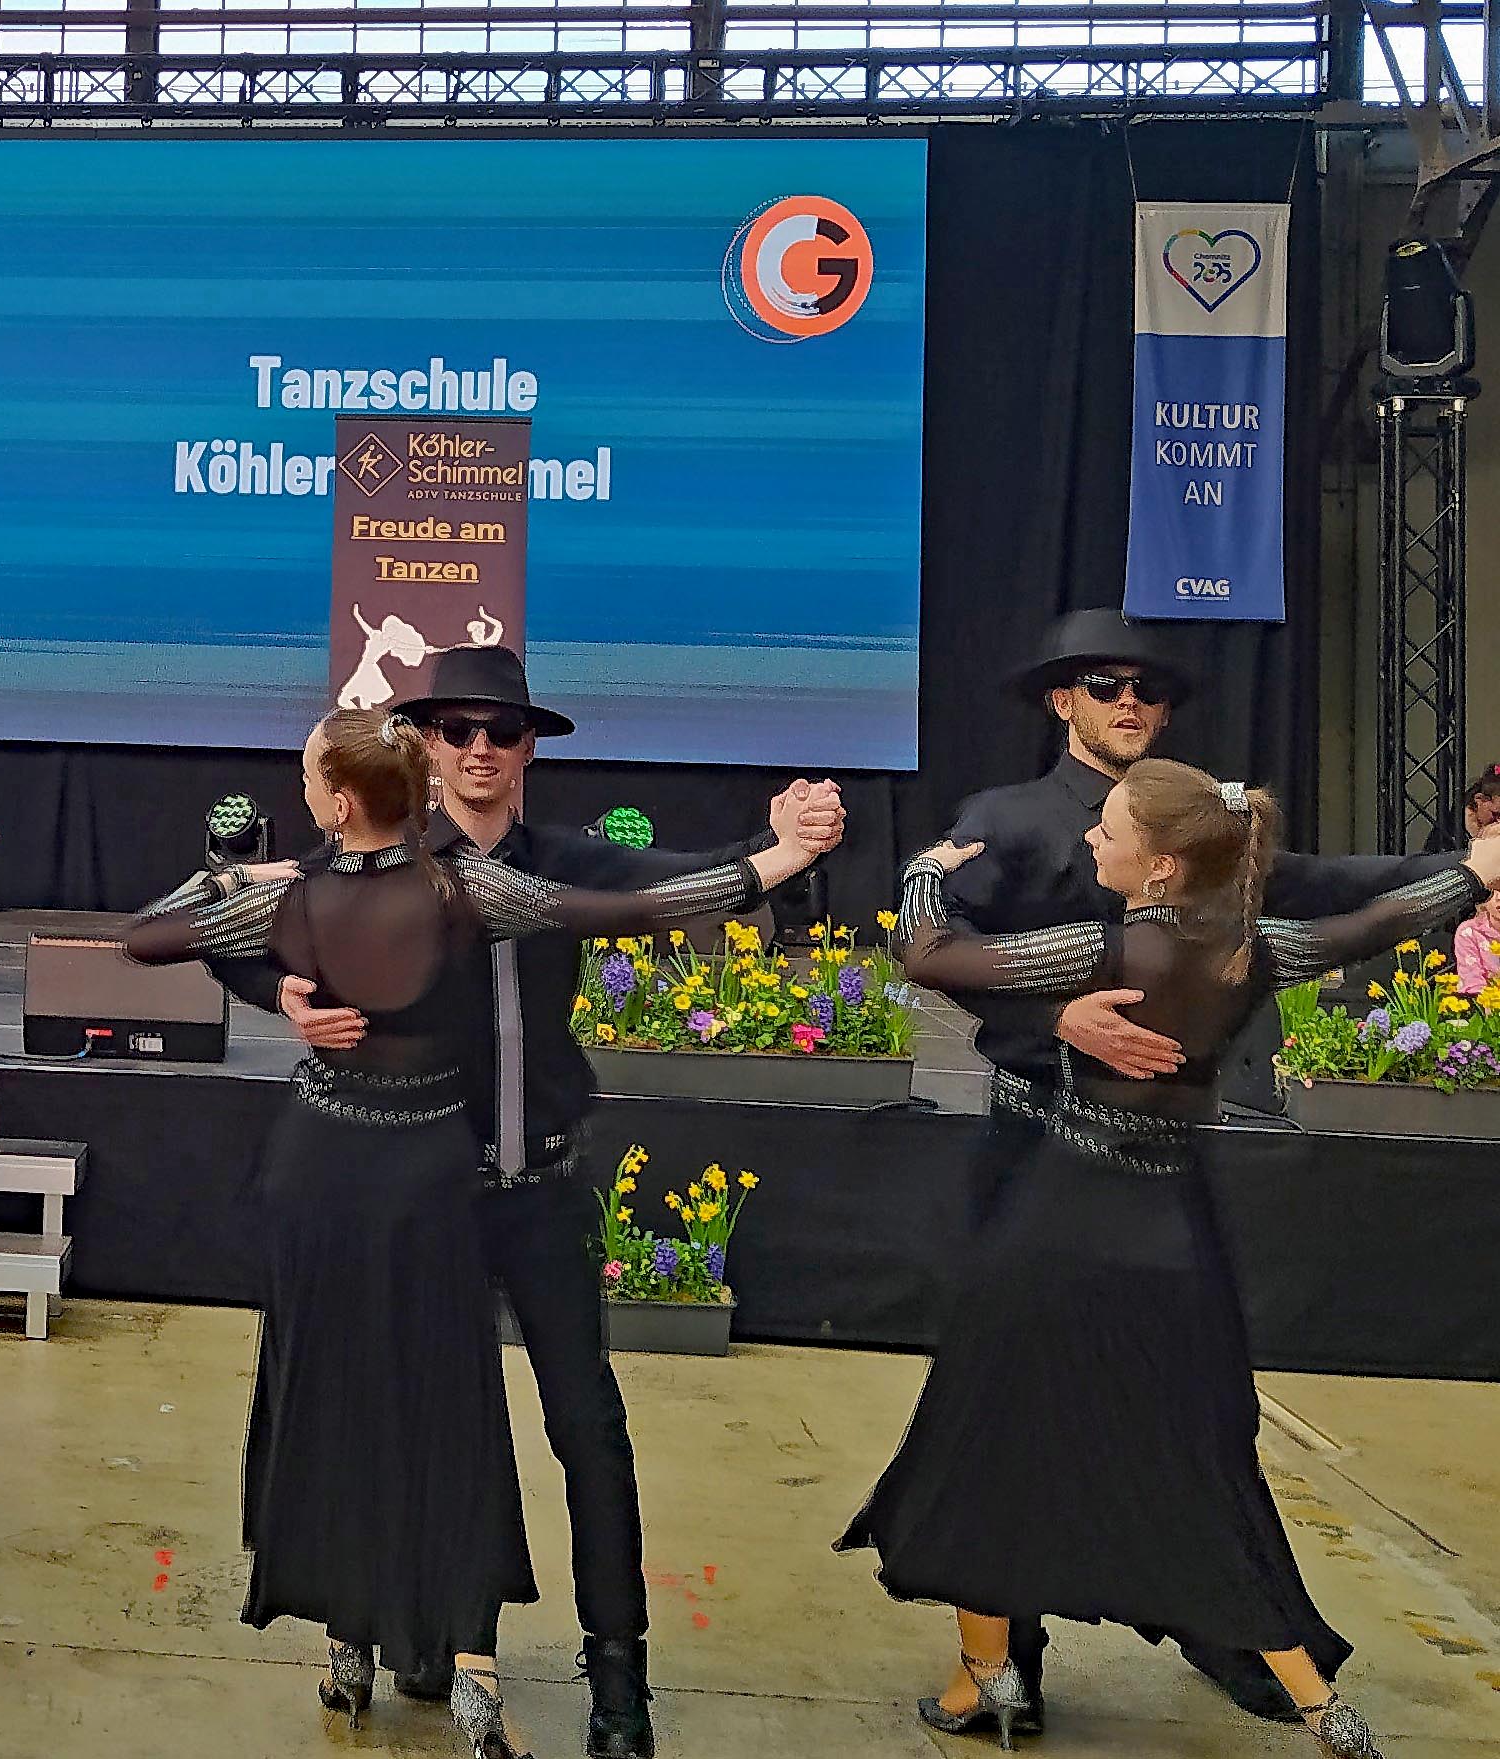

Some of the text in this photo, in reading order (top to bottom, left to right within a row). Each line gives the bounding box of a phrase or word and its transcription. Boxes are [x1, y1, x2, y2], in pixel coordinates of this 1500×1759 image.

[249, 355, 539, 412] Tanzschule
[1155, 401, 1260, 430] KULTUR
[407, 432, 496, 458] Köhler-
[1155, 440, 1258, 469] KOMMT
[407, 458, 524, 485] Schimmel
[407, 489, 523, 502] ADTV TANZSCHULE
[1183, 480, 1223, 506] AN
[352, 515, 505, 540] Freude am
[375, 556, 479, 580] Tanzen
[1175, 577, 1231, 596] CVAG
